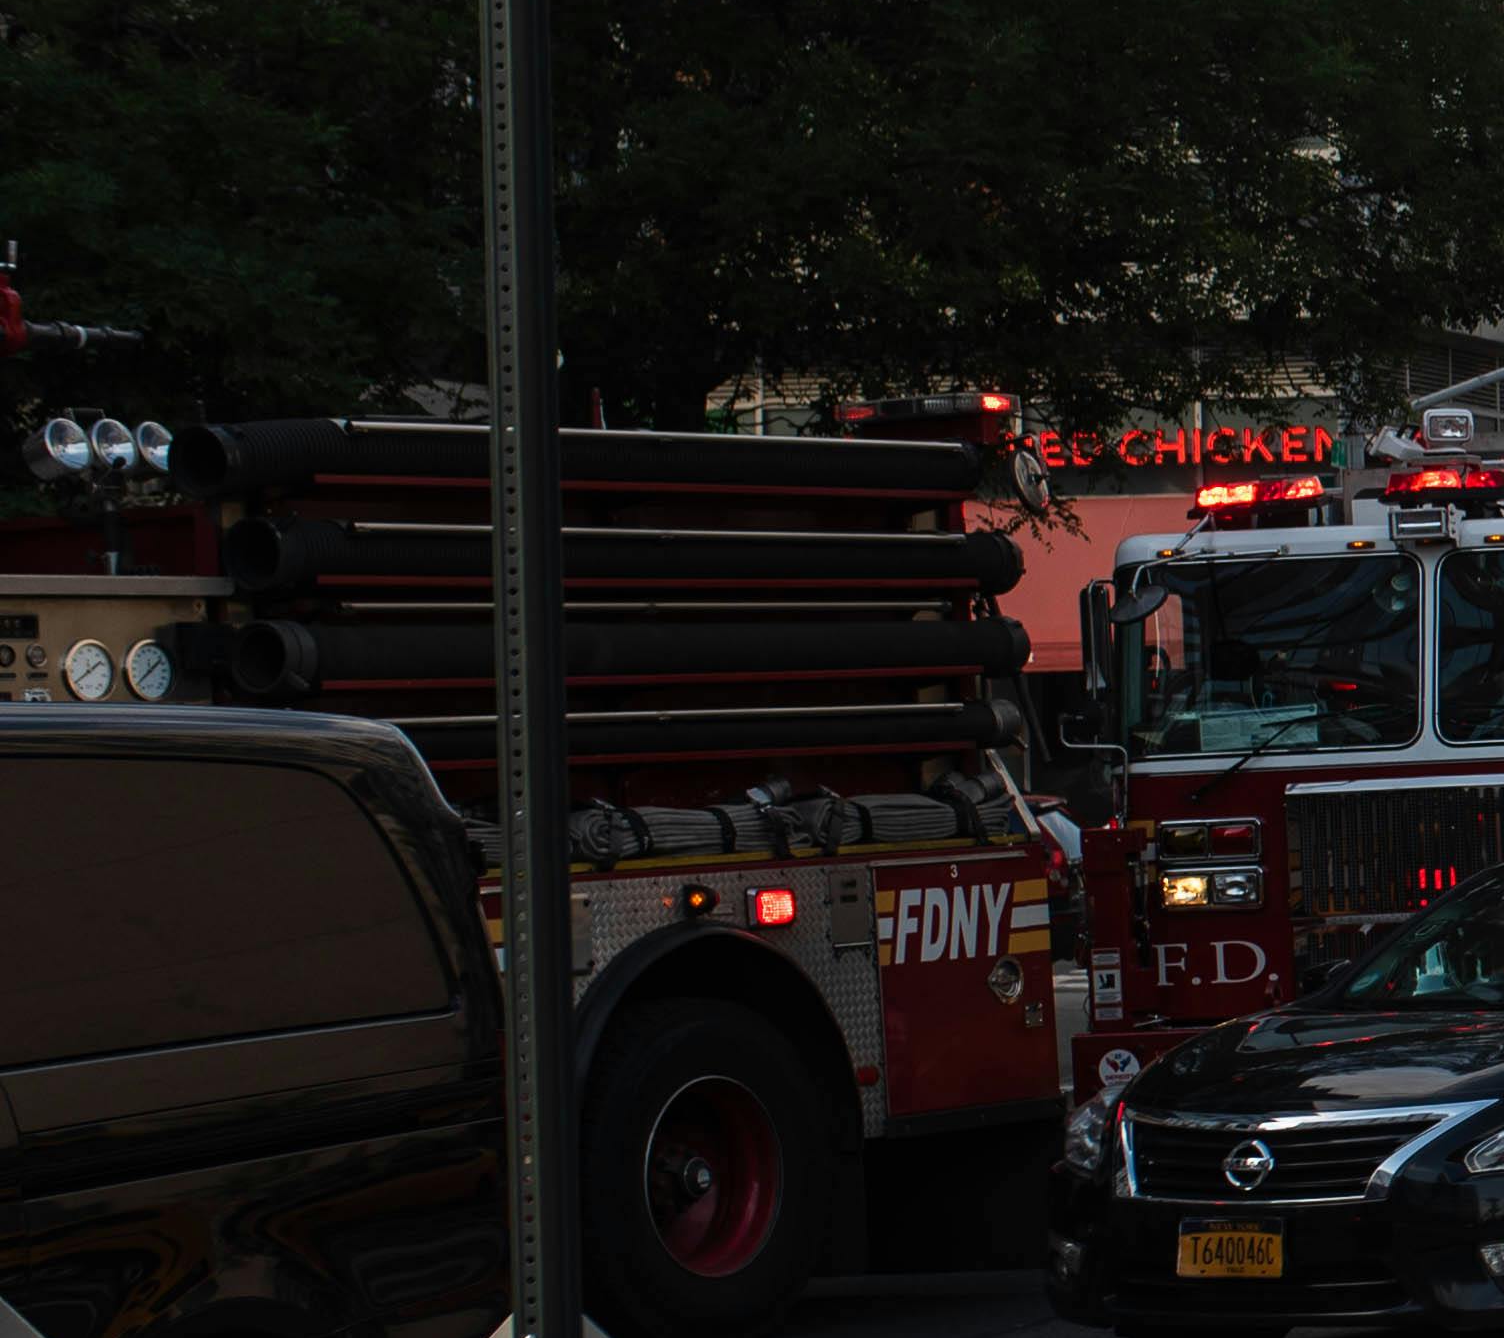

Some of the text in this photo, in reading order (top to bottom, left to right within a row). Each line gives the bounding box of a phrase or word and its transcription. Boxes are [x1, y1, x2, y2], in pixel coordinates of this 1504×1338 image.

[950, 864, 959, 878] 3
[894, 882, 1012, 965] FDNY
[1151, 940, 1279, 987] F.D.
[1190, 1236, 1275, 1265] T640046C
